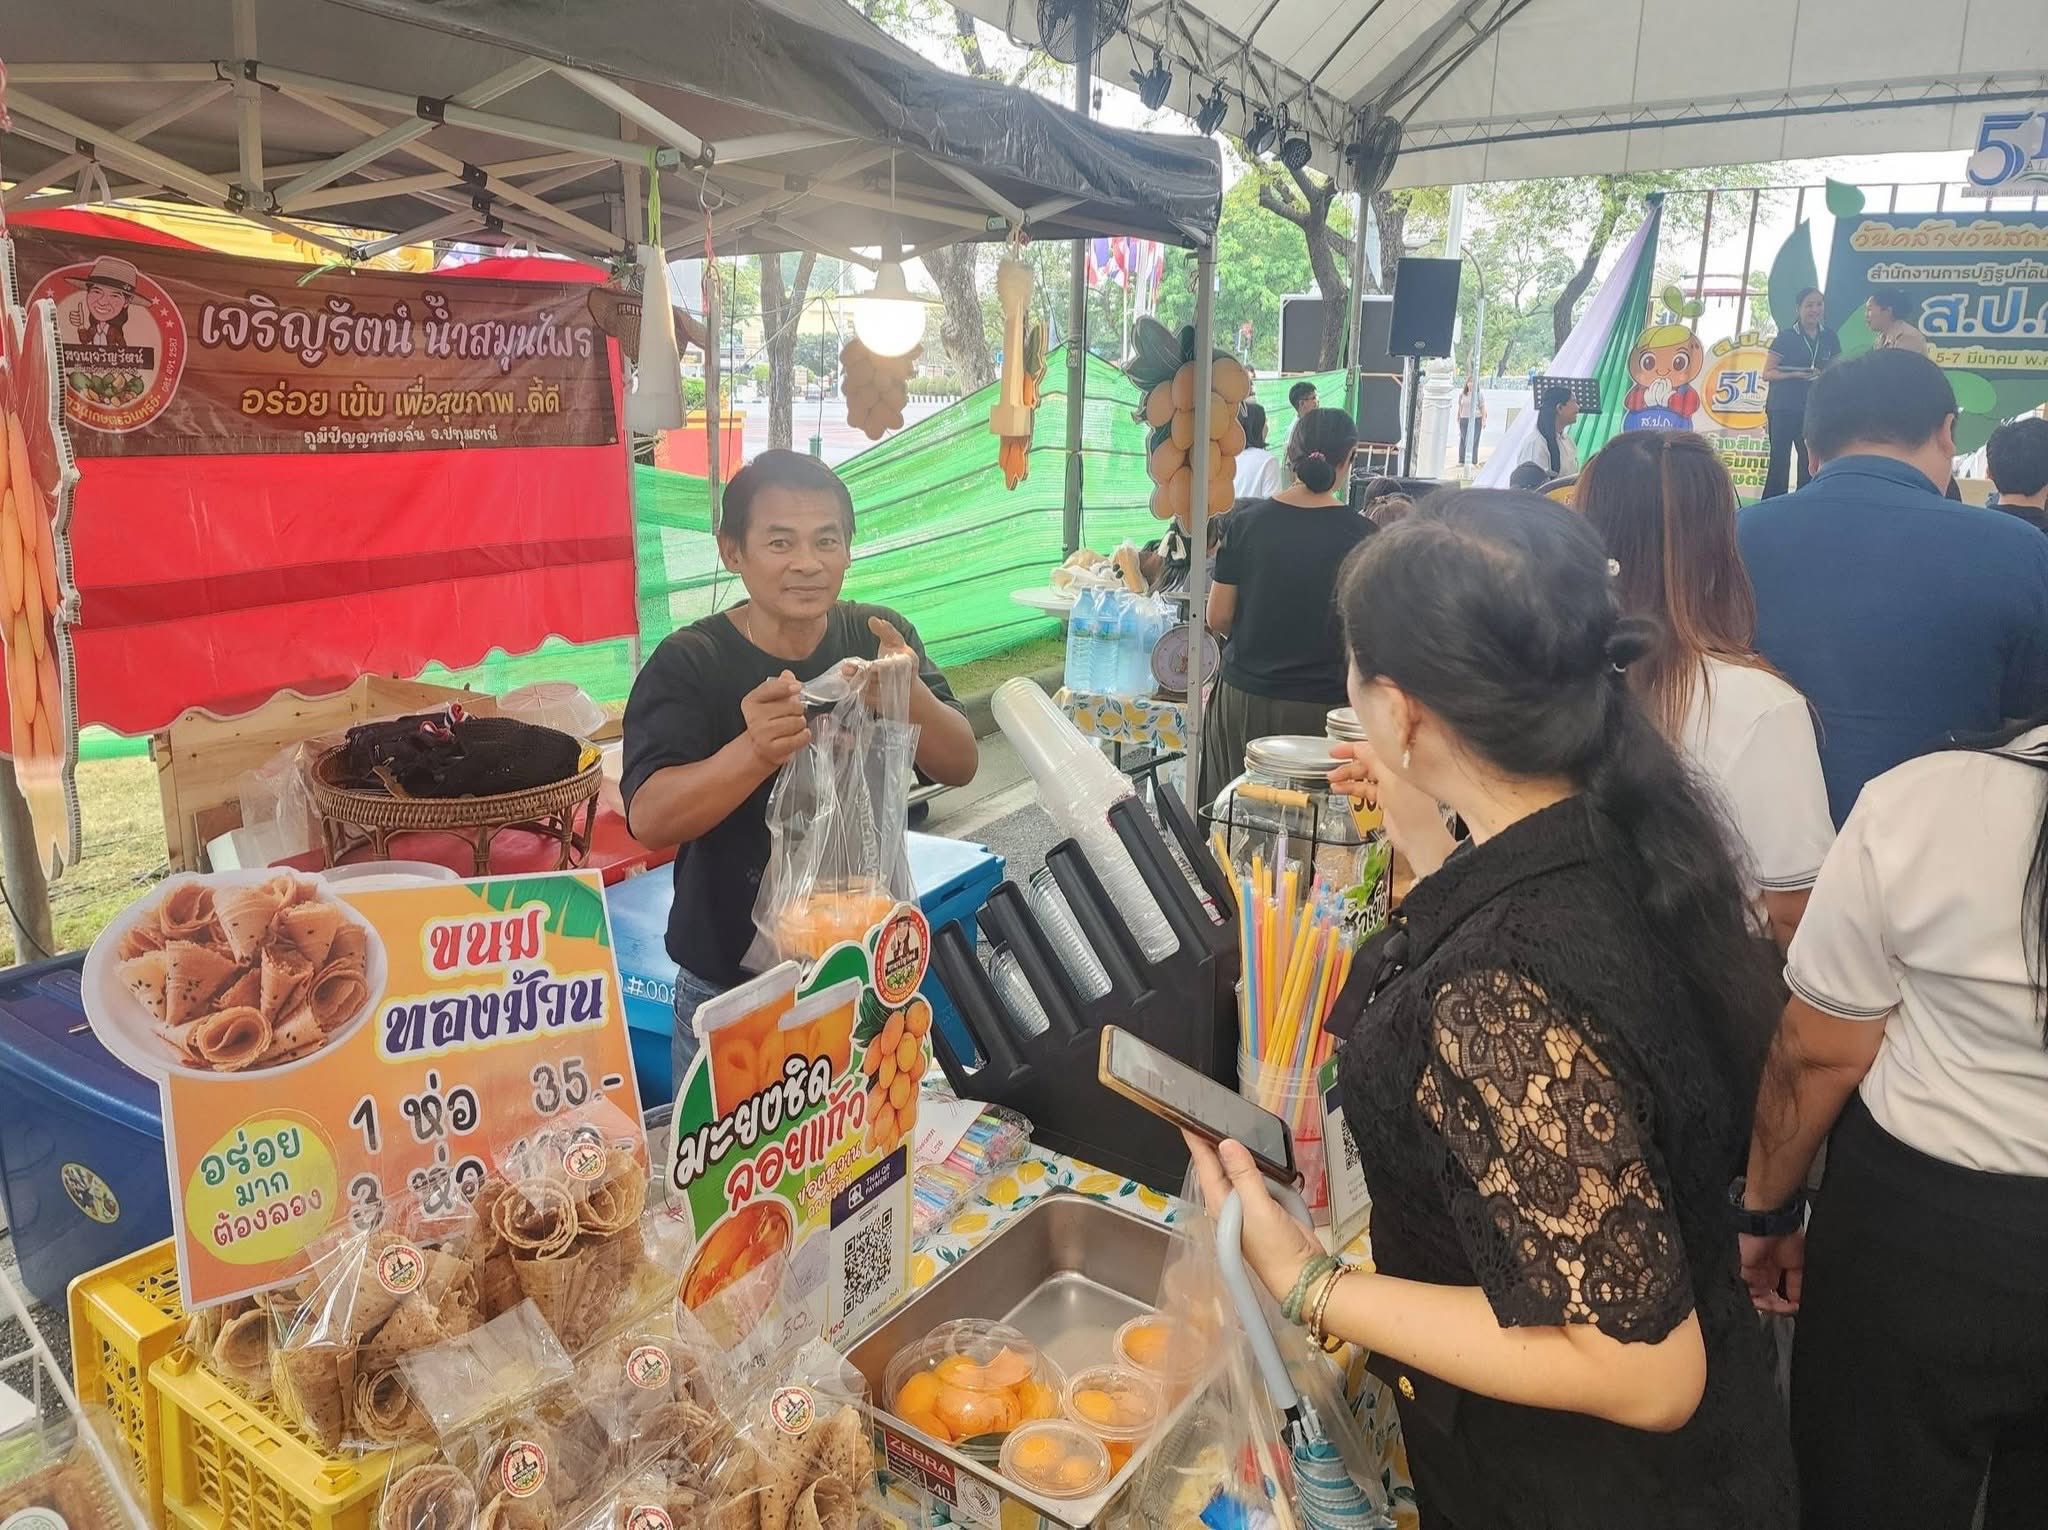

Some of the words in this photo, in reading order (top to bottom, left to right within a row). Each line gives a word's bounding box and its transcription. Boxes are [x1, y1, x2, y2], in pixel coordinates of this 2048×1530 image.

[202, 294, 411, 362] เจริญรัตน์
[426, 294, 592, 371] น้ำสมุนไพร
[1936, 352, 1960, 364] 5-7
[1967, 351, 2018, 365] มีนาคม
[242, 381, 329, 416] อร่อย
[340, 384, 385, 416] เข้ม
[1713, 370, 1758, 405] 51
[430, 909, 544, 971] ขนม
[385, 969, 603, 1054] ทองม้วน
[352, 1099, 377, 1151] 1
[403, 1072, 478, 1141] ห่อ
[676, 1057, 830, 1185] มะยงชิด
[201, 1127, 301, 1186] อร่อย
[727, 1079, 865, 1211] ลอยแก้ว
[235, 1171, 289, 1207] มาก
[865, 1170, 882, 1187] THAI
[865, 1172, 891, 1196] PAYMENT
[213, 1188, 322, 1246] ต้องลอง
[888, 1434, 952, 1479] ZEBRA
